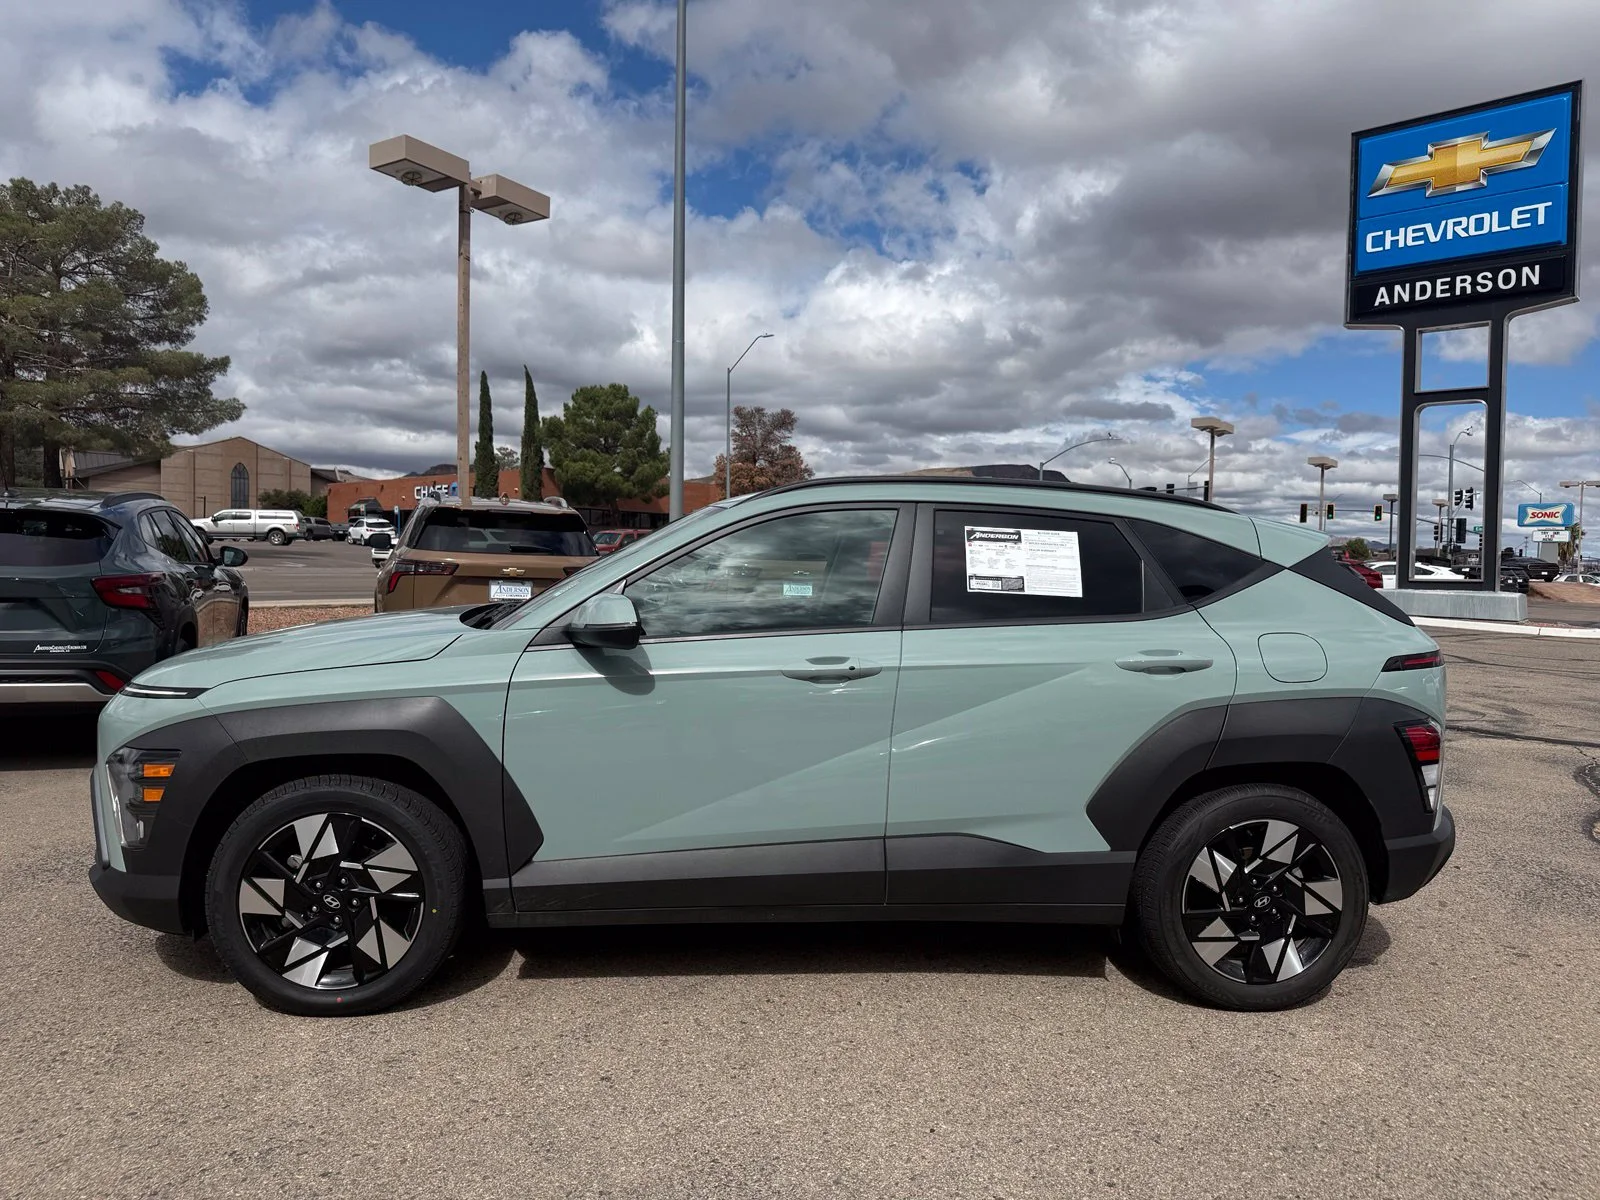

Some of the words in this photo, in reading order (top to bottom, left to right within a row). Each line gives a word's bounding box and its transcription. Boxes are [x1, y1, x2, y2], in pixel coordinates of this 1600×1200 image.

[1366, 201, 1553, 254] CHEVROLET
[1374, 264, 1541, 307] ANDERSON
[1529, 511, 1561, 519] SONIC
[969, 531, 1019, 540] ANDERSON
[493, 584, 530, 597] ANDERSON
